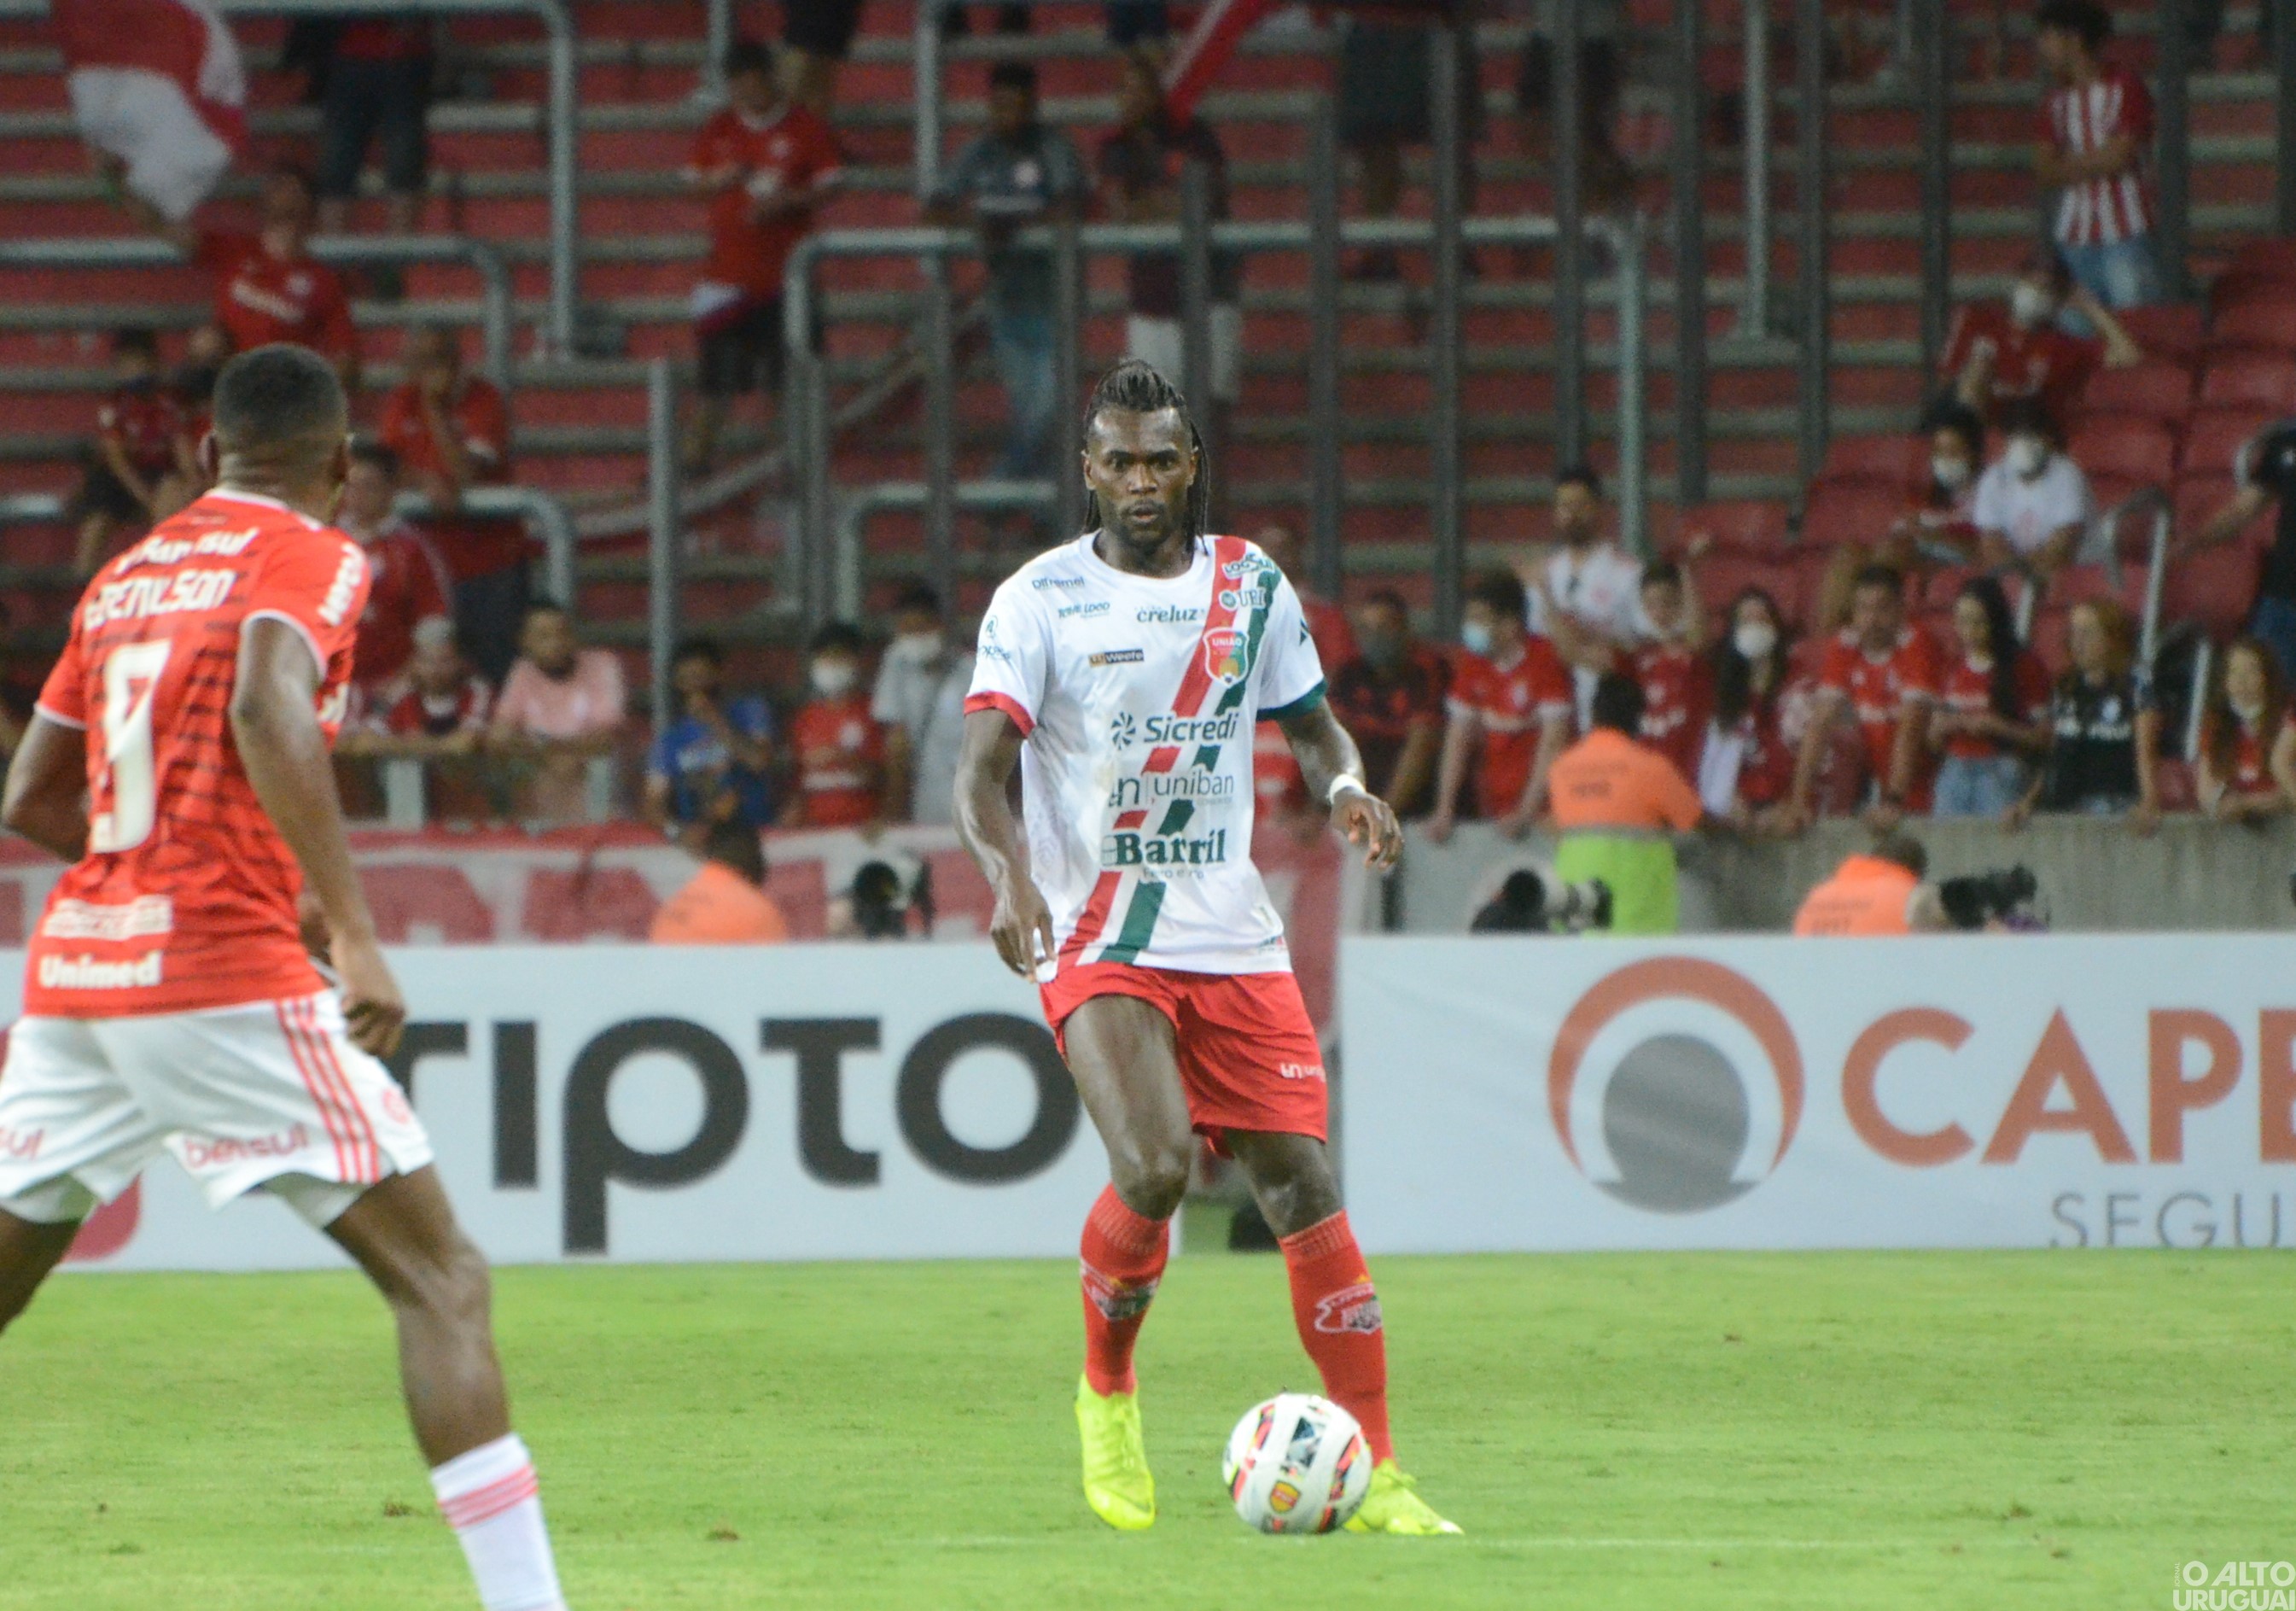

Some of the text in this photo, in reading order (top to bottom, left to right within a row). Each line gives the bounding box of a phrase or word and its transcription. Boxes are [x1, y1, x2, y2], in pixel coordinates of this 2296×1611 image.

[1137, 604, 1198, 622] creluz
[1144, 712, 1239, 742] Sicredi
[1154, 770, 1234, 796] uniban
[1114, 828, 1227, 866] Barril
[39, 949, 162, 989] Unimed
